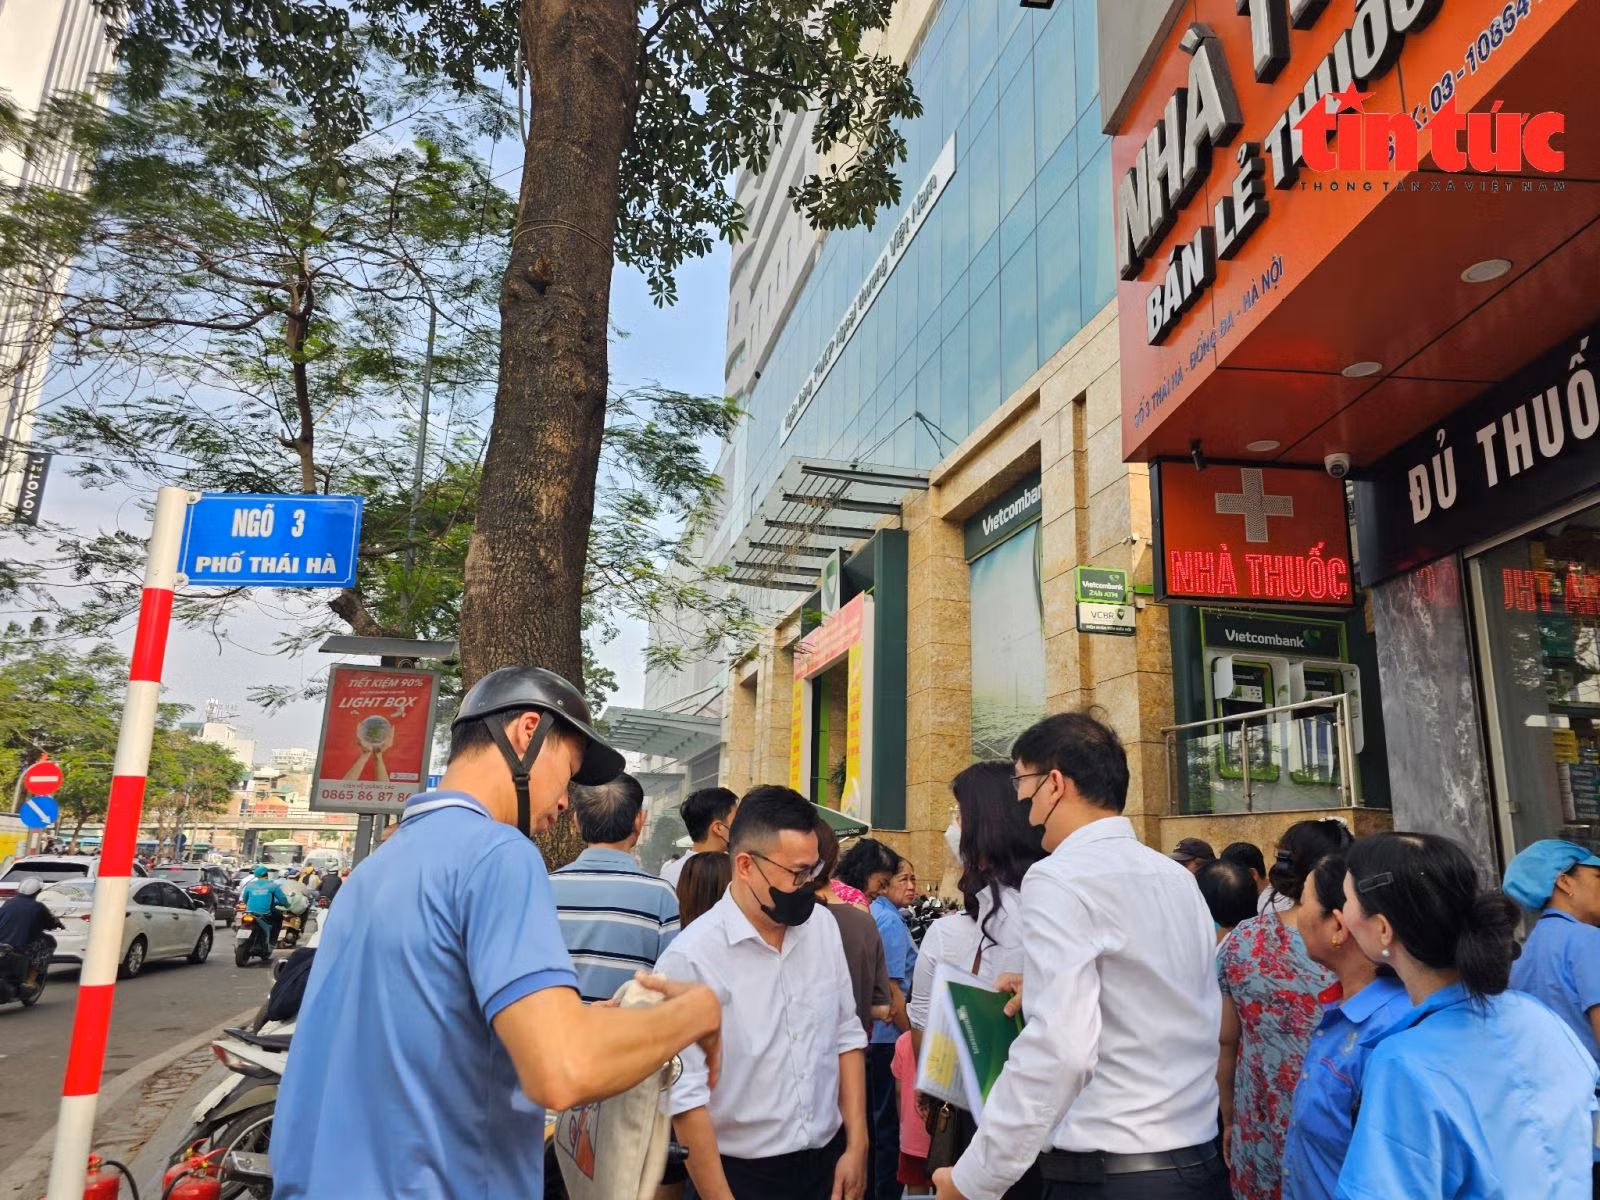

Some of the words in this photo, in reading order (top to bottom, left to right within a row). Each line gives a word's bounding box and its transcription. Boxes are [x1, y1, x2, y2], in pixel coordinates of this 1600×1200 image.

[1118, 24, 1240, 280] NHÀ
[1146, 227, 1213, 345] BÁN
[1215, 143, 1267, 260] LẺ
[1407, 428, 1457, 525] ĐỦ
[1475, 335, 1600, 488] THUỐ
[231, 503, 275, 538] NGÕ
[291, 508, 306, 538] 3
[194, 550, 246, 574] PHỐ
[248, 552, 300, 574] THÁI
[305, 552, 337, 574] HÀ
[1170, 543, 1238, 595] NHÀ
[1245, 541, 1348, 600] THUỐC
[1081, 580, 1124, 591] Vietcombank
[1225, 628, 1304, 648] Vietcombank
[401, 678, 424, 687] 90%
[338, 697, 384, 708] LIGHT
[384, 696, 418, 708] BOX
[321, 789, 354, 800] 0865
[357, 791, 374, 801] 86
[378, 792, 394, 802] 87
